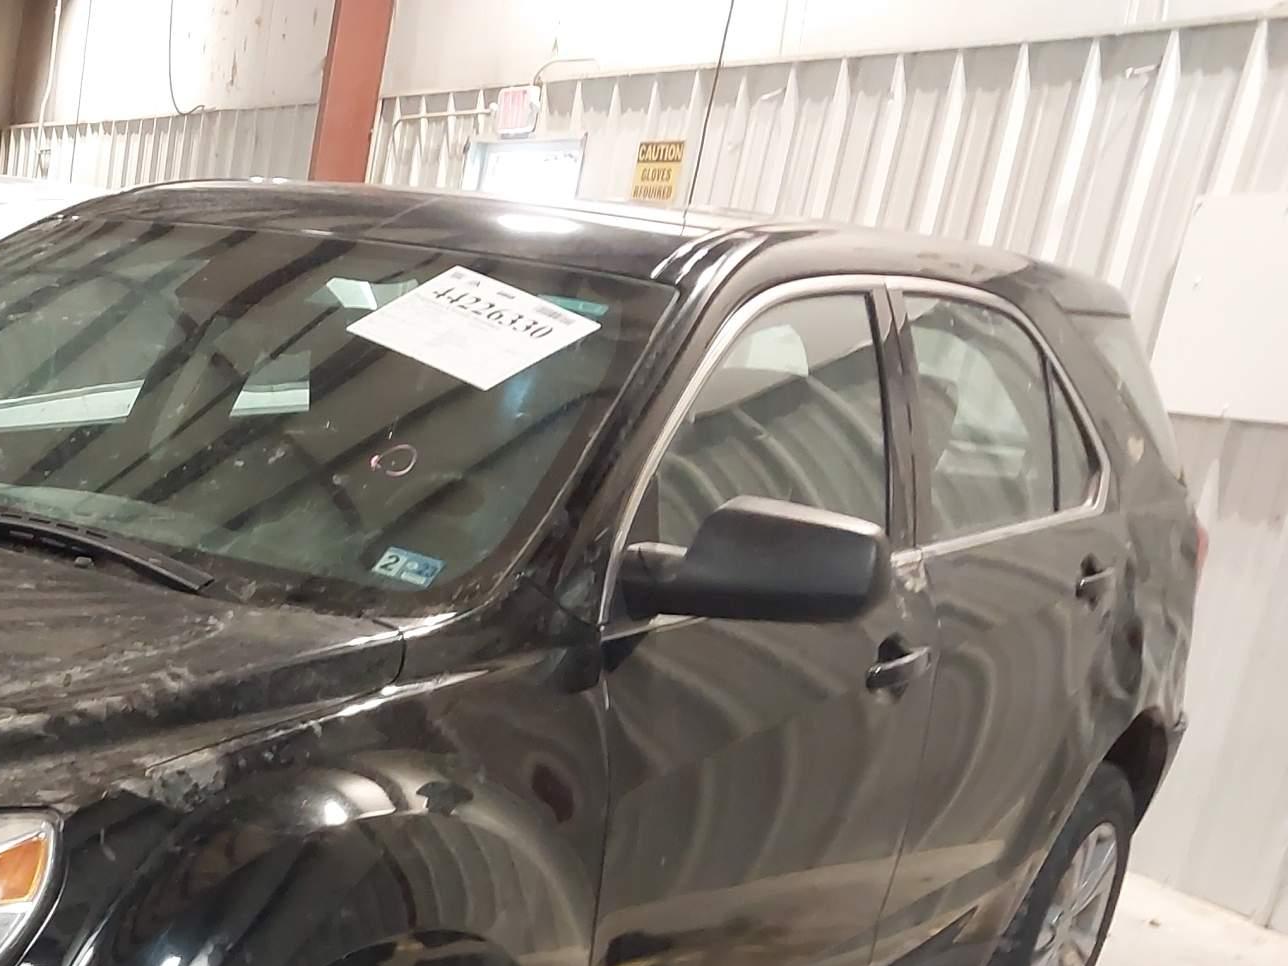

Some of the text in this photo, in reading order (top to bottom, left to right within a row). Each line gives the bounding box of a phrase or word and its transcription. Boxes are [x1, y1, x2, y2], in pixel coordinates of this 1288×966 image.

[639, 143, 684, 161] CAUTION
[641, 168, 672, 181] GLOVES
[633, 185, 673, 199] REQUIRED
[431, 285, 554, 340] 44226330
[379, 554, 400, 572] 2
